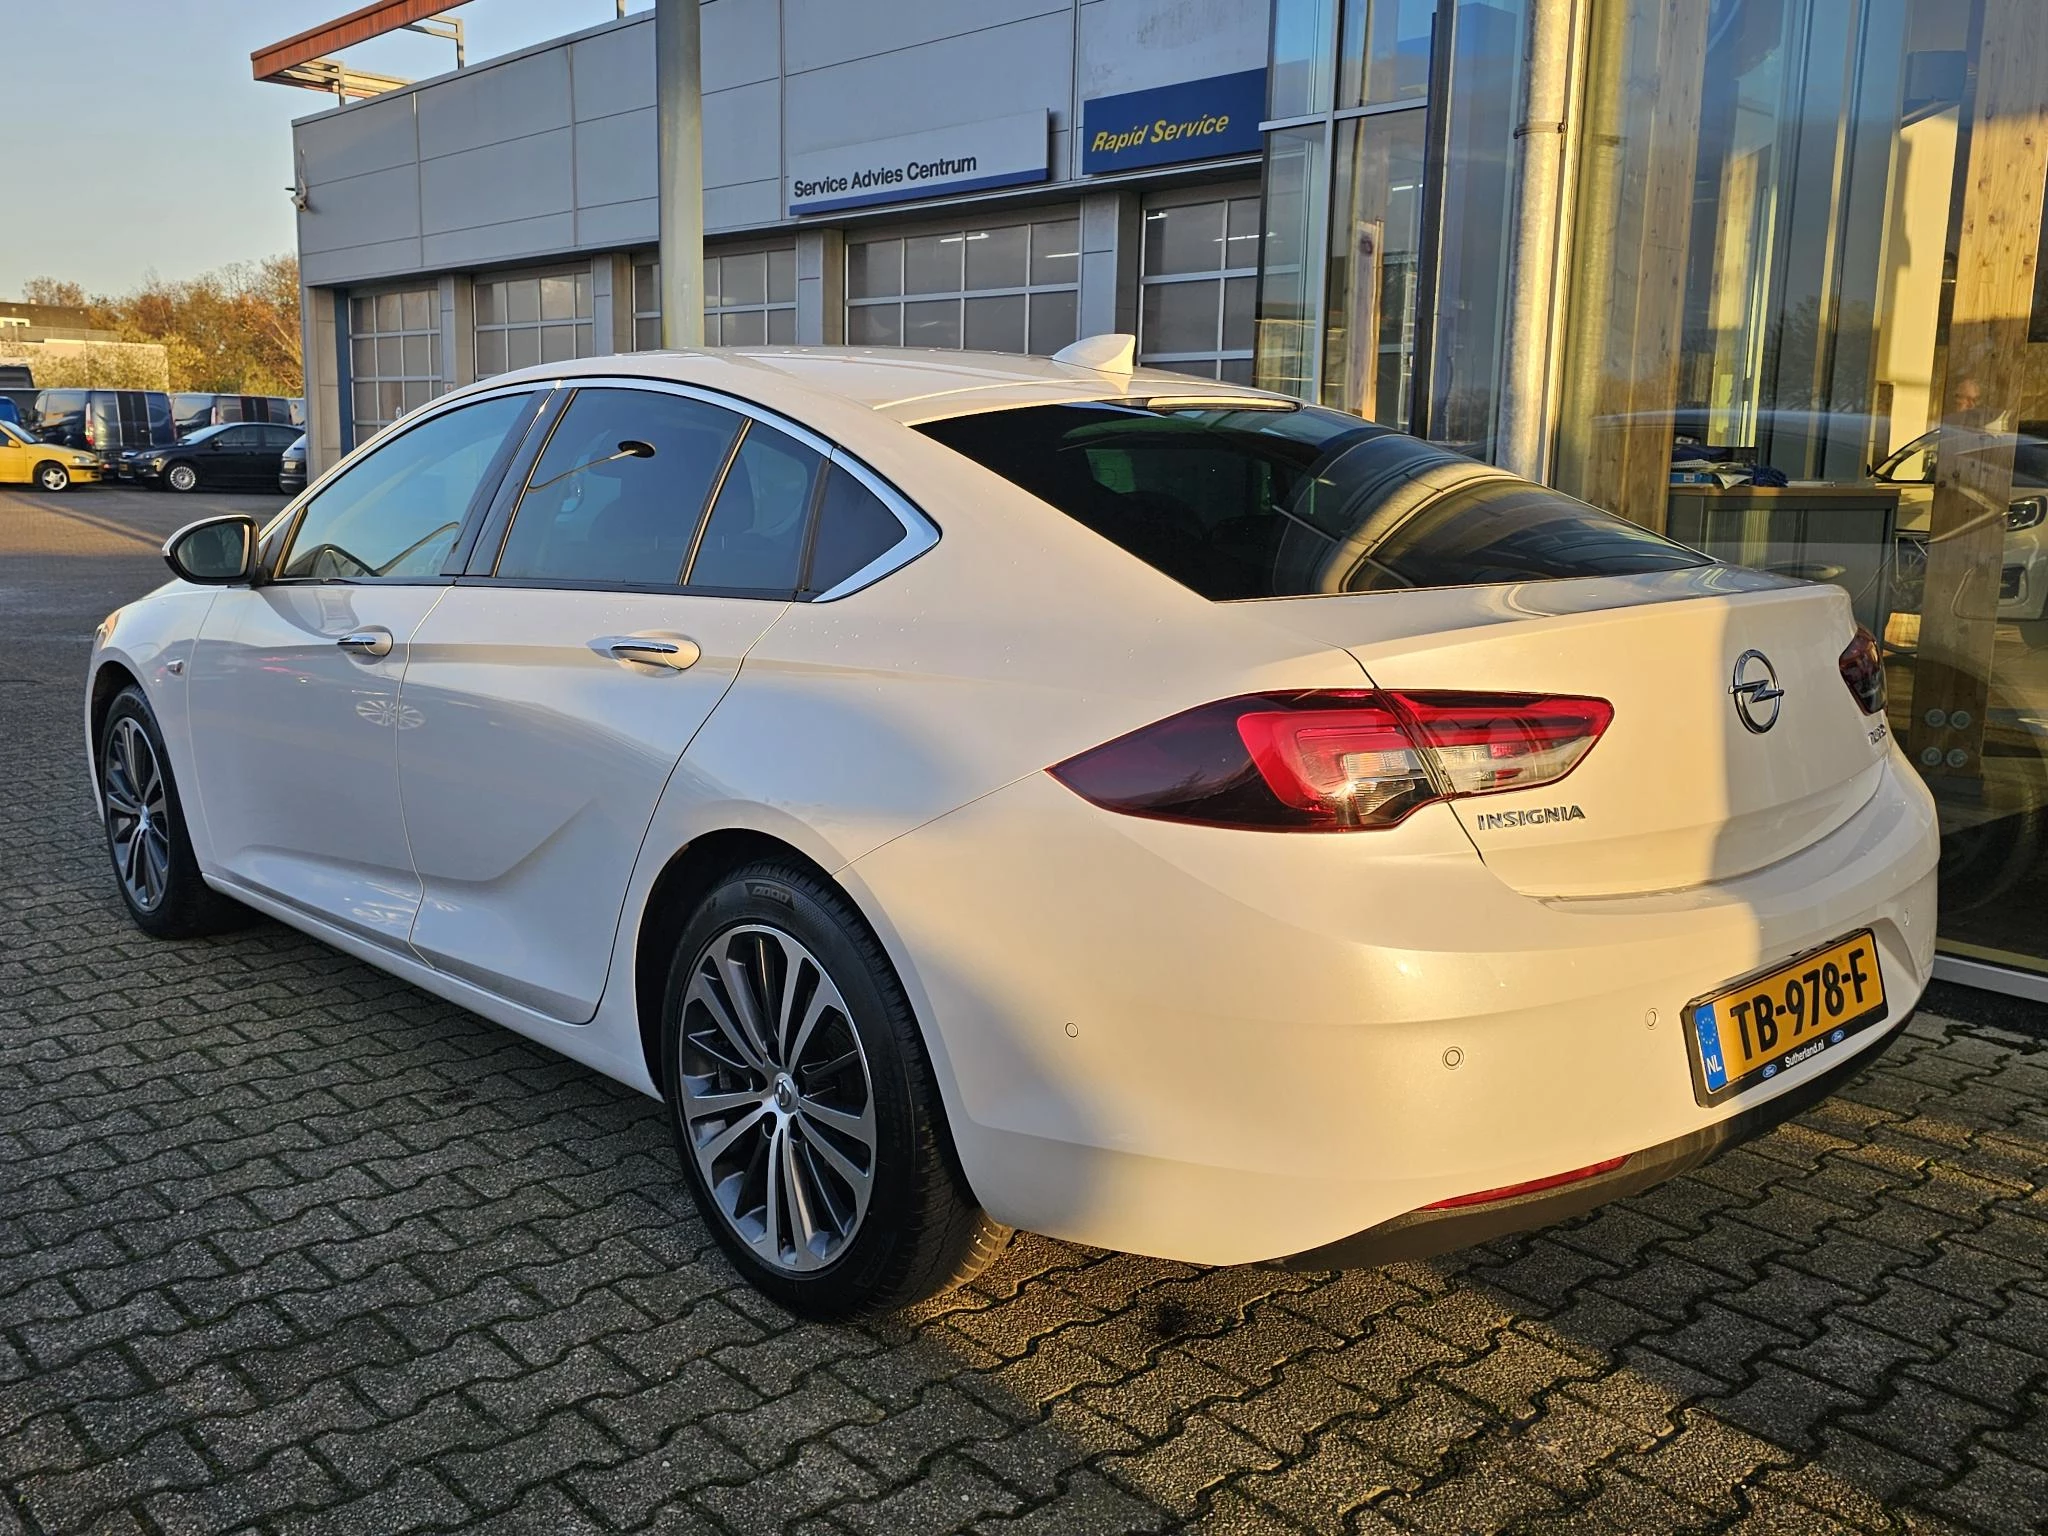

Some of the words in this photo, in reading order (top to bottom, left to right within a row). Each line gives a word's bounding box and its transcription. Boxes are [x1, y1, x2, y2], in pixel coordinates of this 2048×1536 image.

[1091, 124, 1149, 153] Rapid
[1150, 114, 1229, 143] Service
[794, 176, 848, 198] Service
[851, 167, 904, 190] Advies
[906, 156, 977, 181] Centrum
[1477, 805, 1586, 831] INSIGNIA
[1730, 948, 1867, 1061] TB-978-F
[1706, 1054, 1722, 1075] NL
[1784, 1039, 1825, 1068] Sutherland.nl
